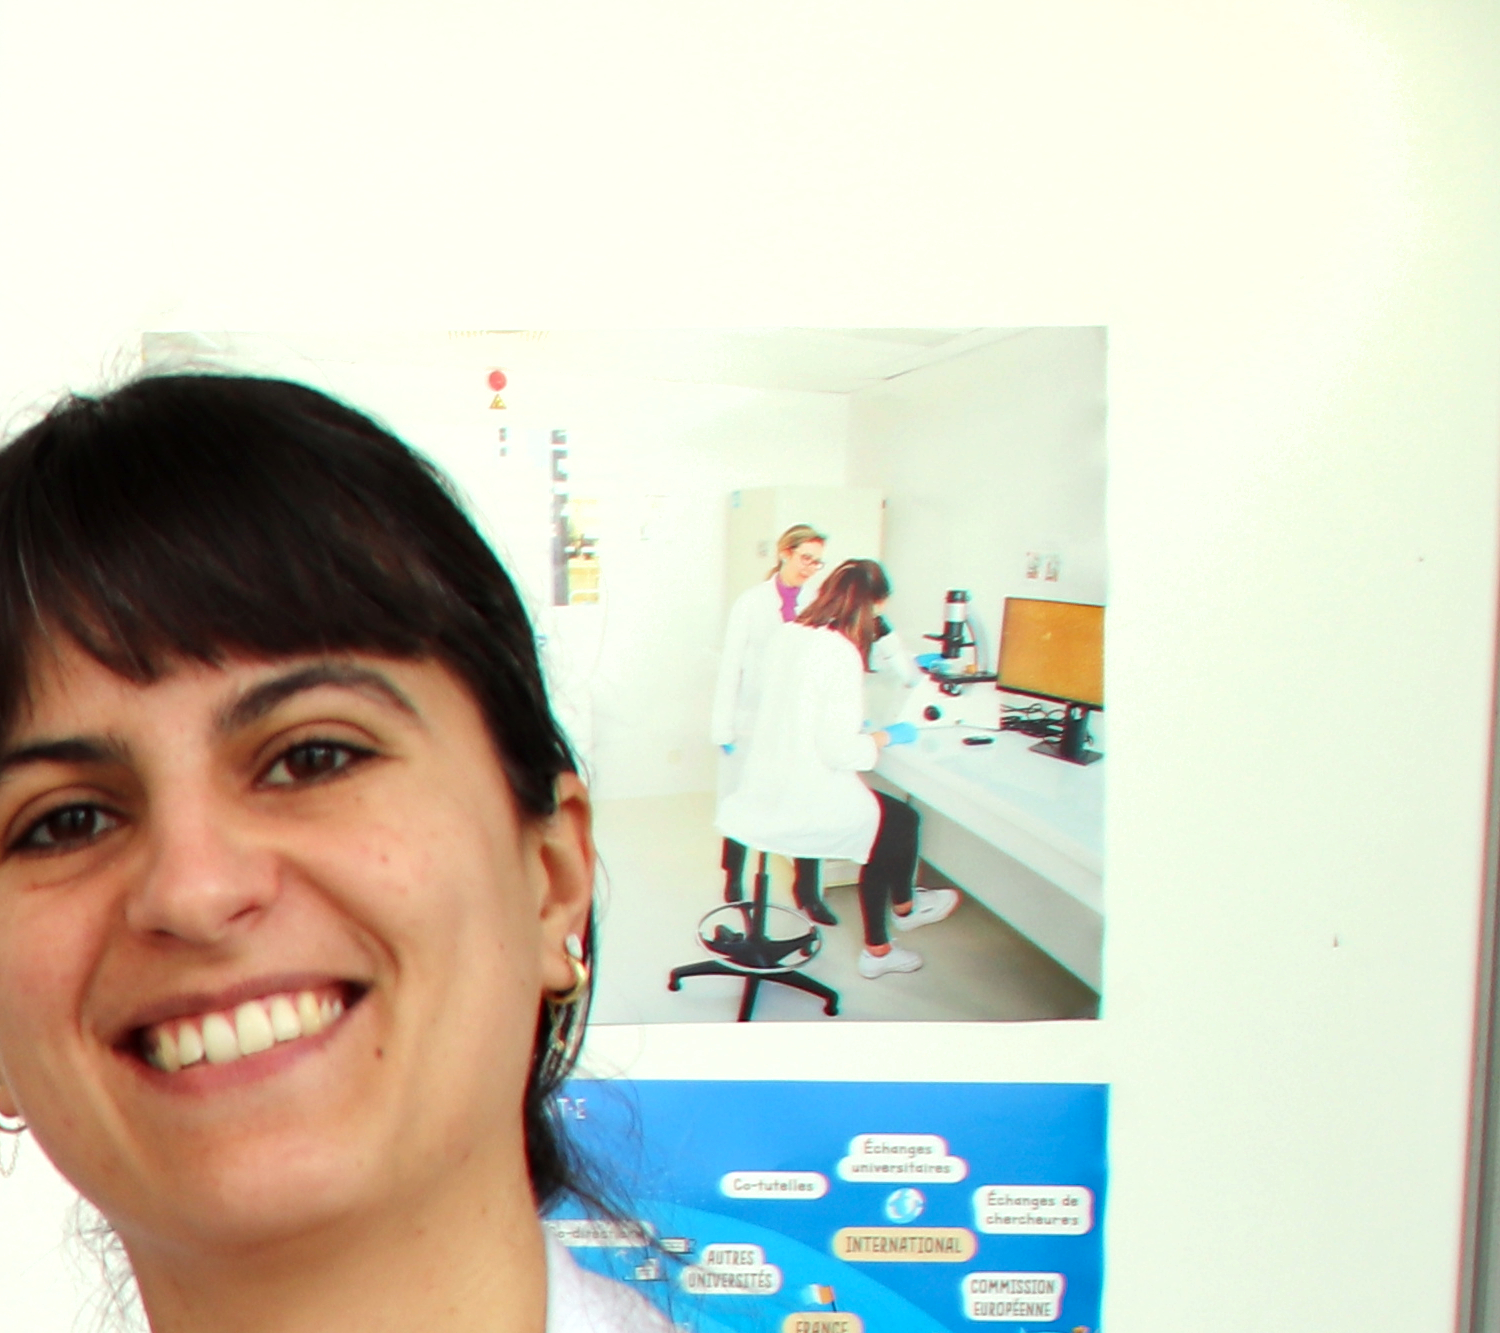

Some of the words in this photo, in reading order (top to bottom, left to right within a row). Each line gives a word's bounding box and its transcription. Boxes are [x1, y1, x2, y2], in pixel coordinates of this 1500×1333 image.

[863, 1140, 932, 1157] Échanges
[852, 1162, 951, 1174] universitaires
[733, 1178, 815, 1192] Co-tutelles
[987, 1192, 1056, 1209] Échanges
[1062, 1196, 1078, 1207] de
[845, 1236, 962, 1254] INTERNATIONAL
[707, 1250, 754, 1265] AUTRES
[970, 1279, 1055, 1294] COMMISSION
[973, 1299, 1051, 1317] EUROPÉENNE
